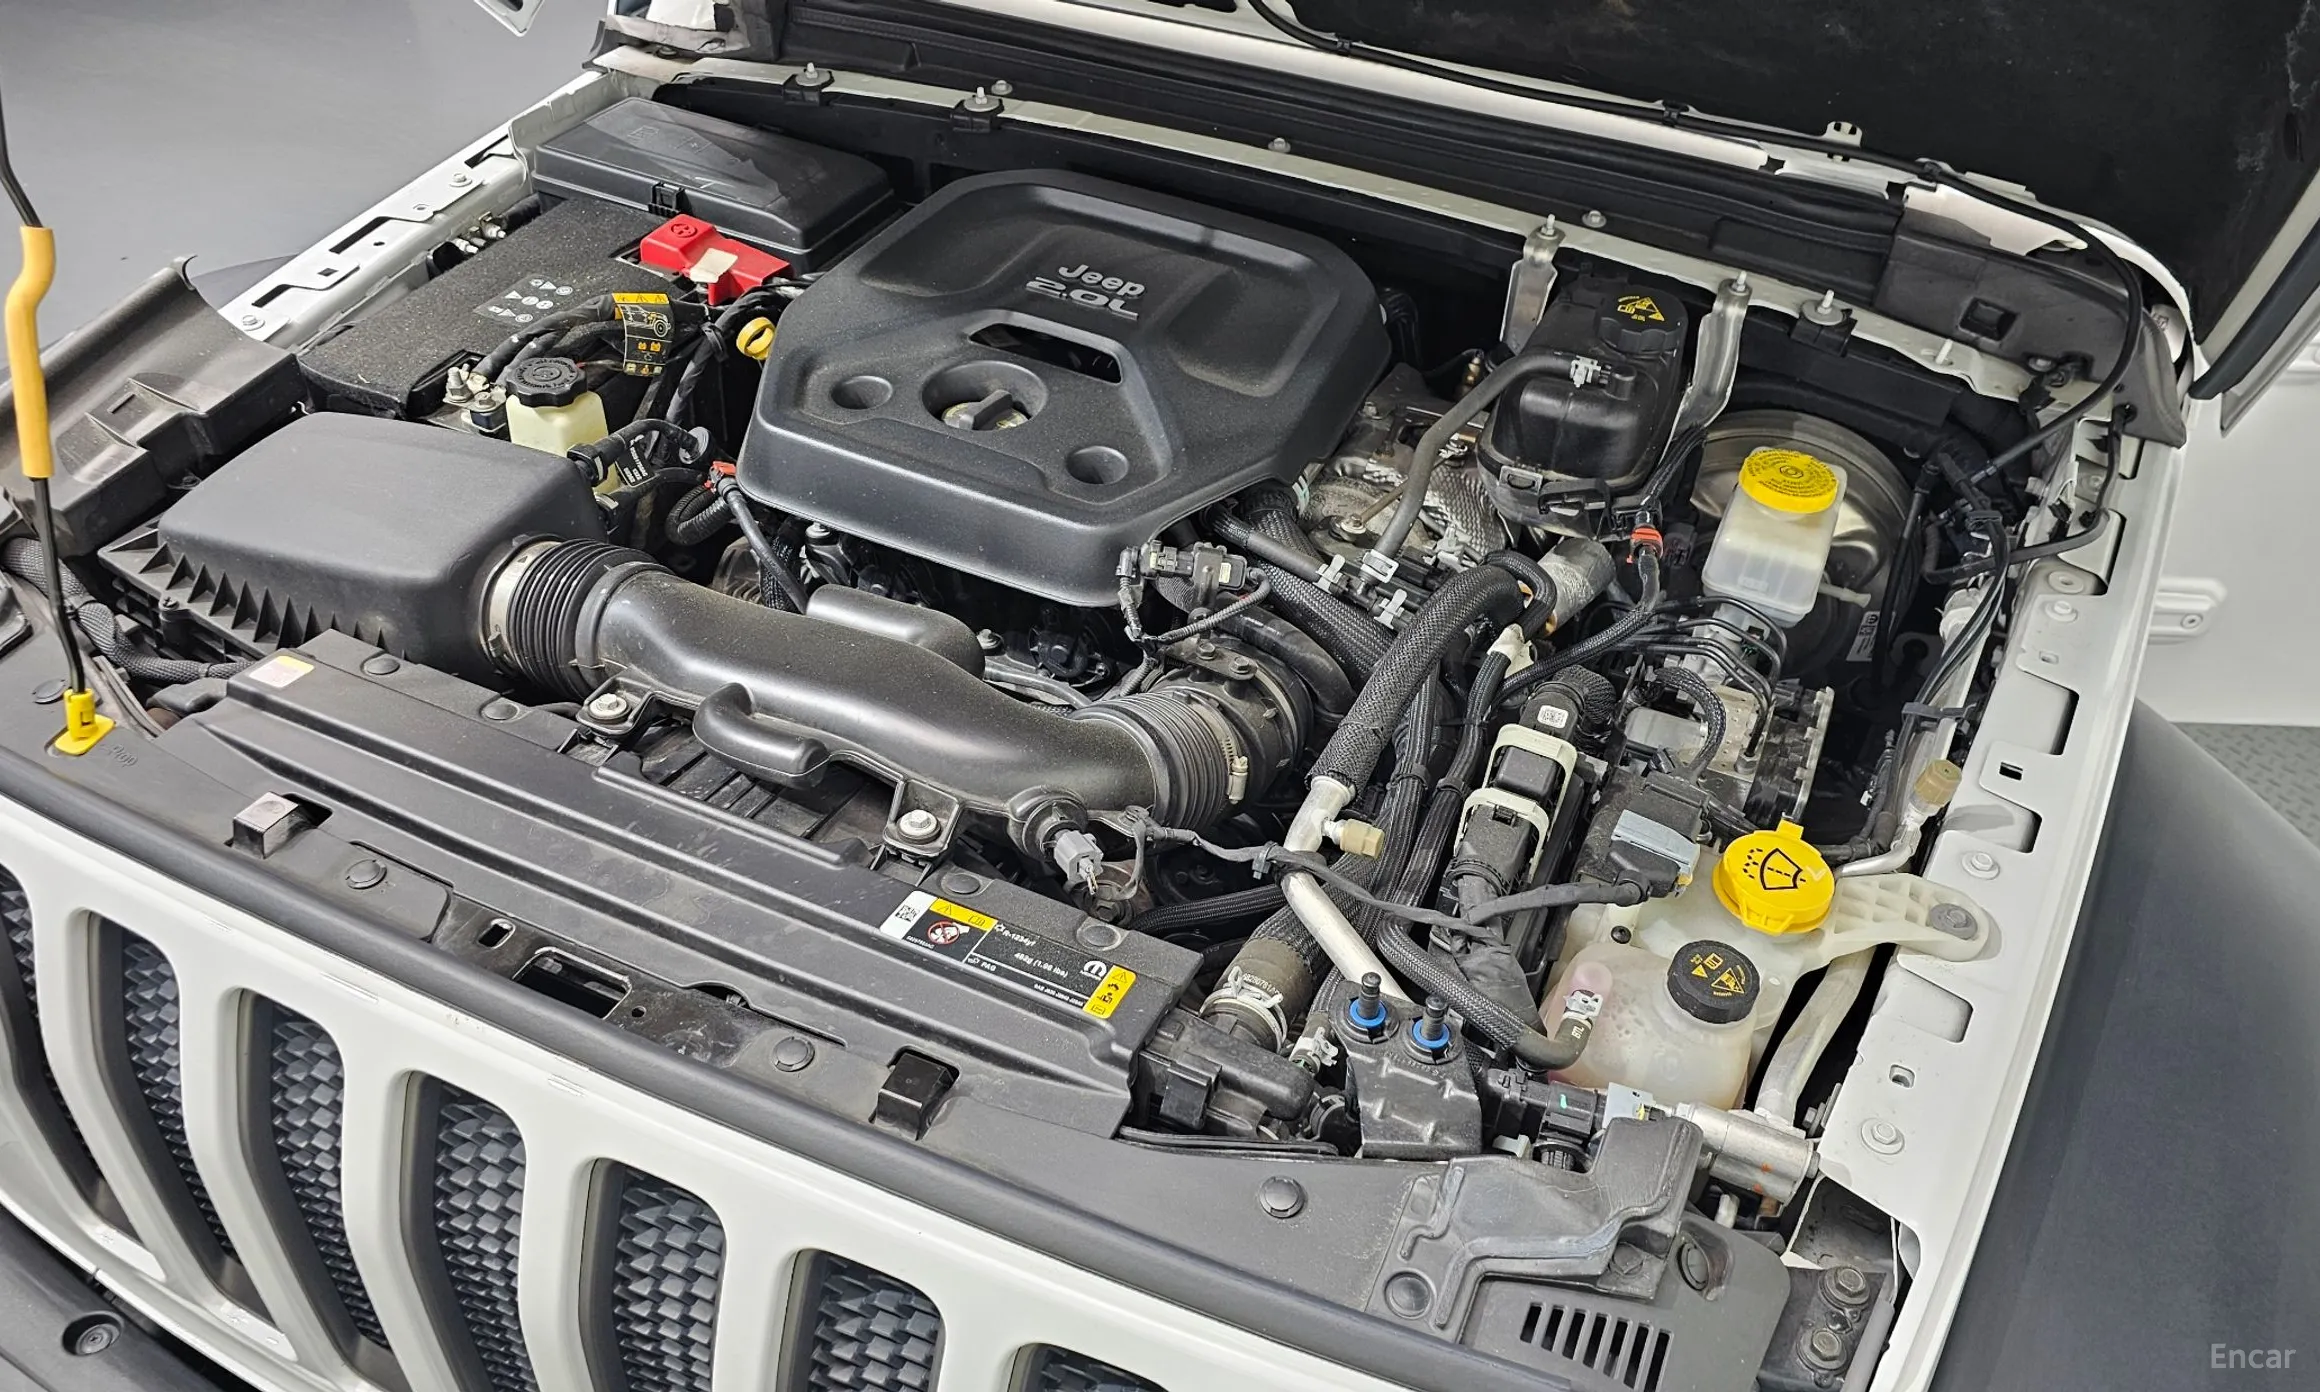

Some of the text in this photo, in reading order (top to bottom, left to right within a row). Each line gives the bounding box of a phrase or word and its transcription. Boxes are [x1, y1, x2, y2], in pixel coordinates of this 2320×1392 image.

[1058, 264, 1145, 297] Jeep
[1026, 276, 1138, 320] 2.0L
[1002, 930, 1036, 946] R-1234yf
